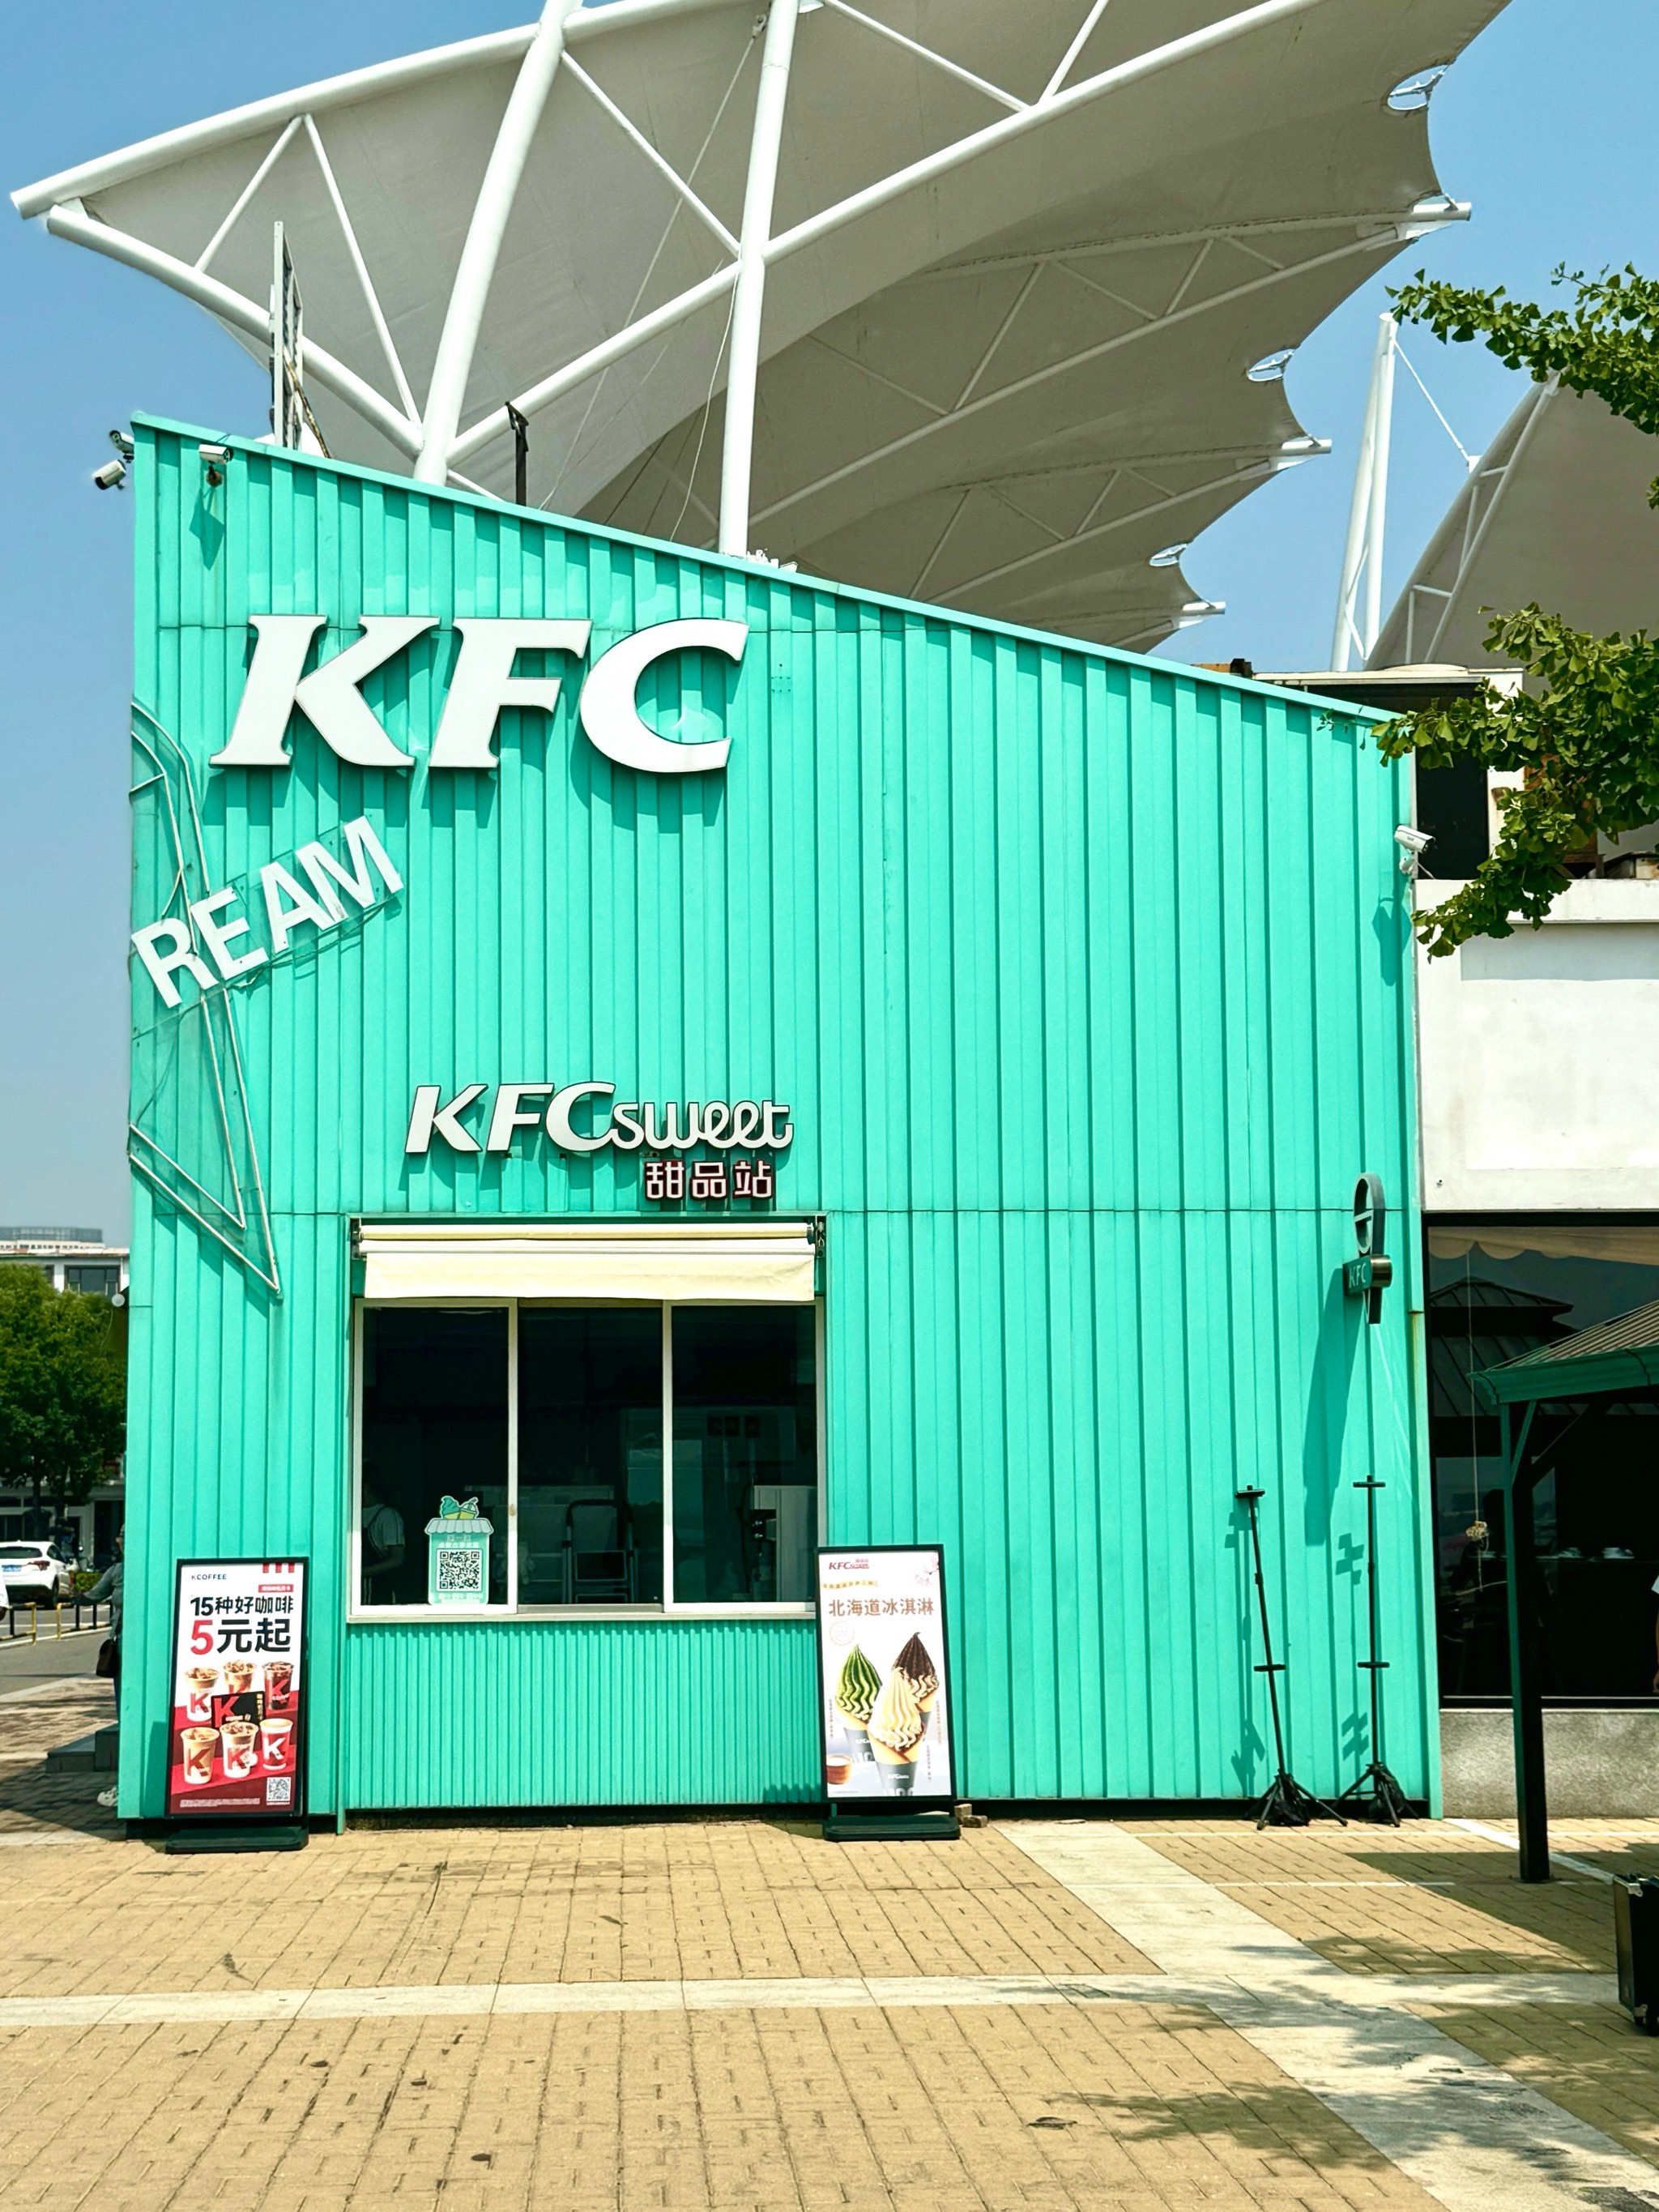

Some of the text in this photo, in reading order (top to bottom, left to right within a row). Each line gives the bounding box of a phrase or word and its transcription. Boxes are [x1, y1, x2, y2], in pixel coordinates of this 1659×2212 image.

[209, 613, 750, 774] KFC
[130, 814, 404, 1009] REAM
[645, 1159, 774, 1200] 甜品站
[1349, 1262, 1367, 1289] KFC
[190, 1595, 293, 1616] 15种好咖啡
[829, 1598, 934, 1616] 北海道冰淇淋
[190, 1617, 291, 1655] 5元起
[263, 1737, 287, 1761] K
